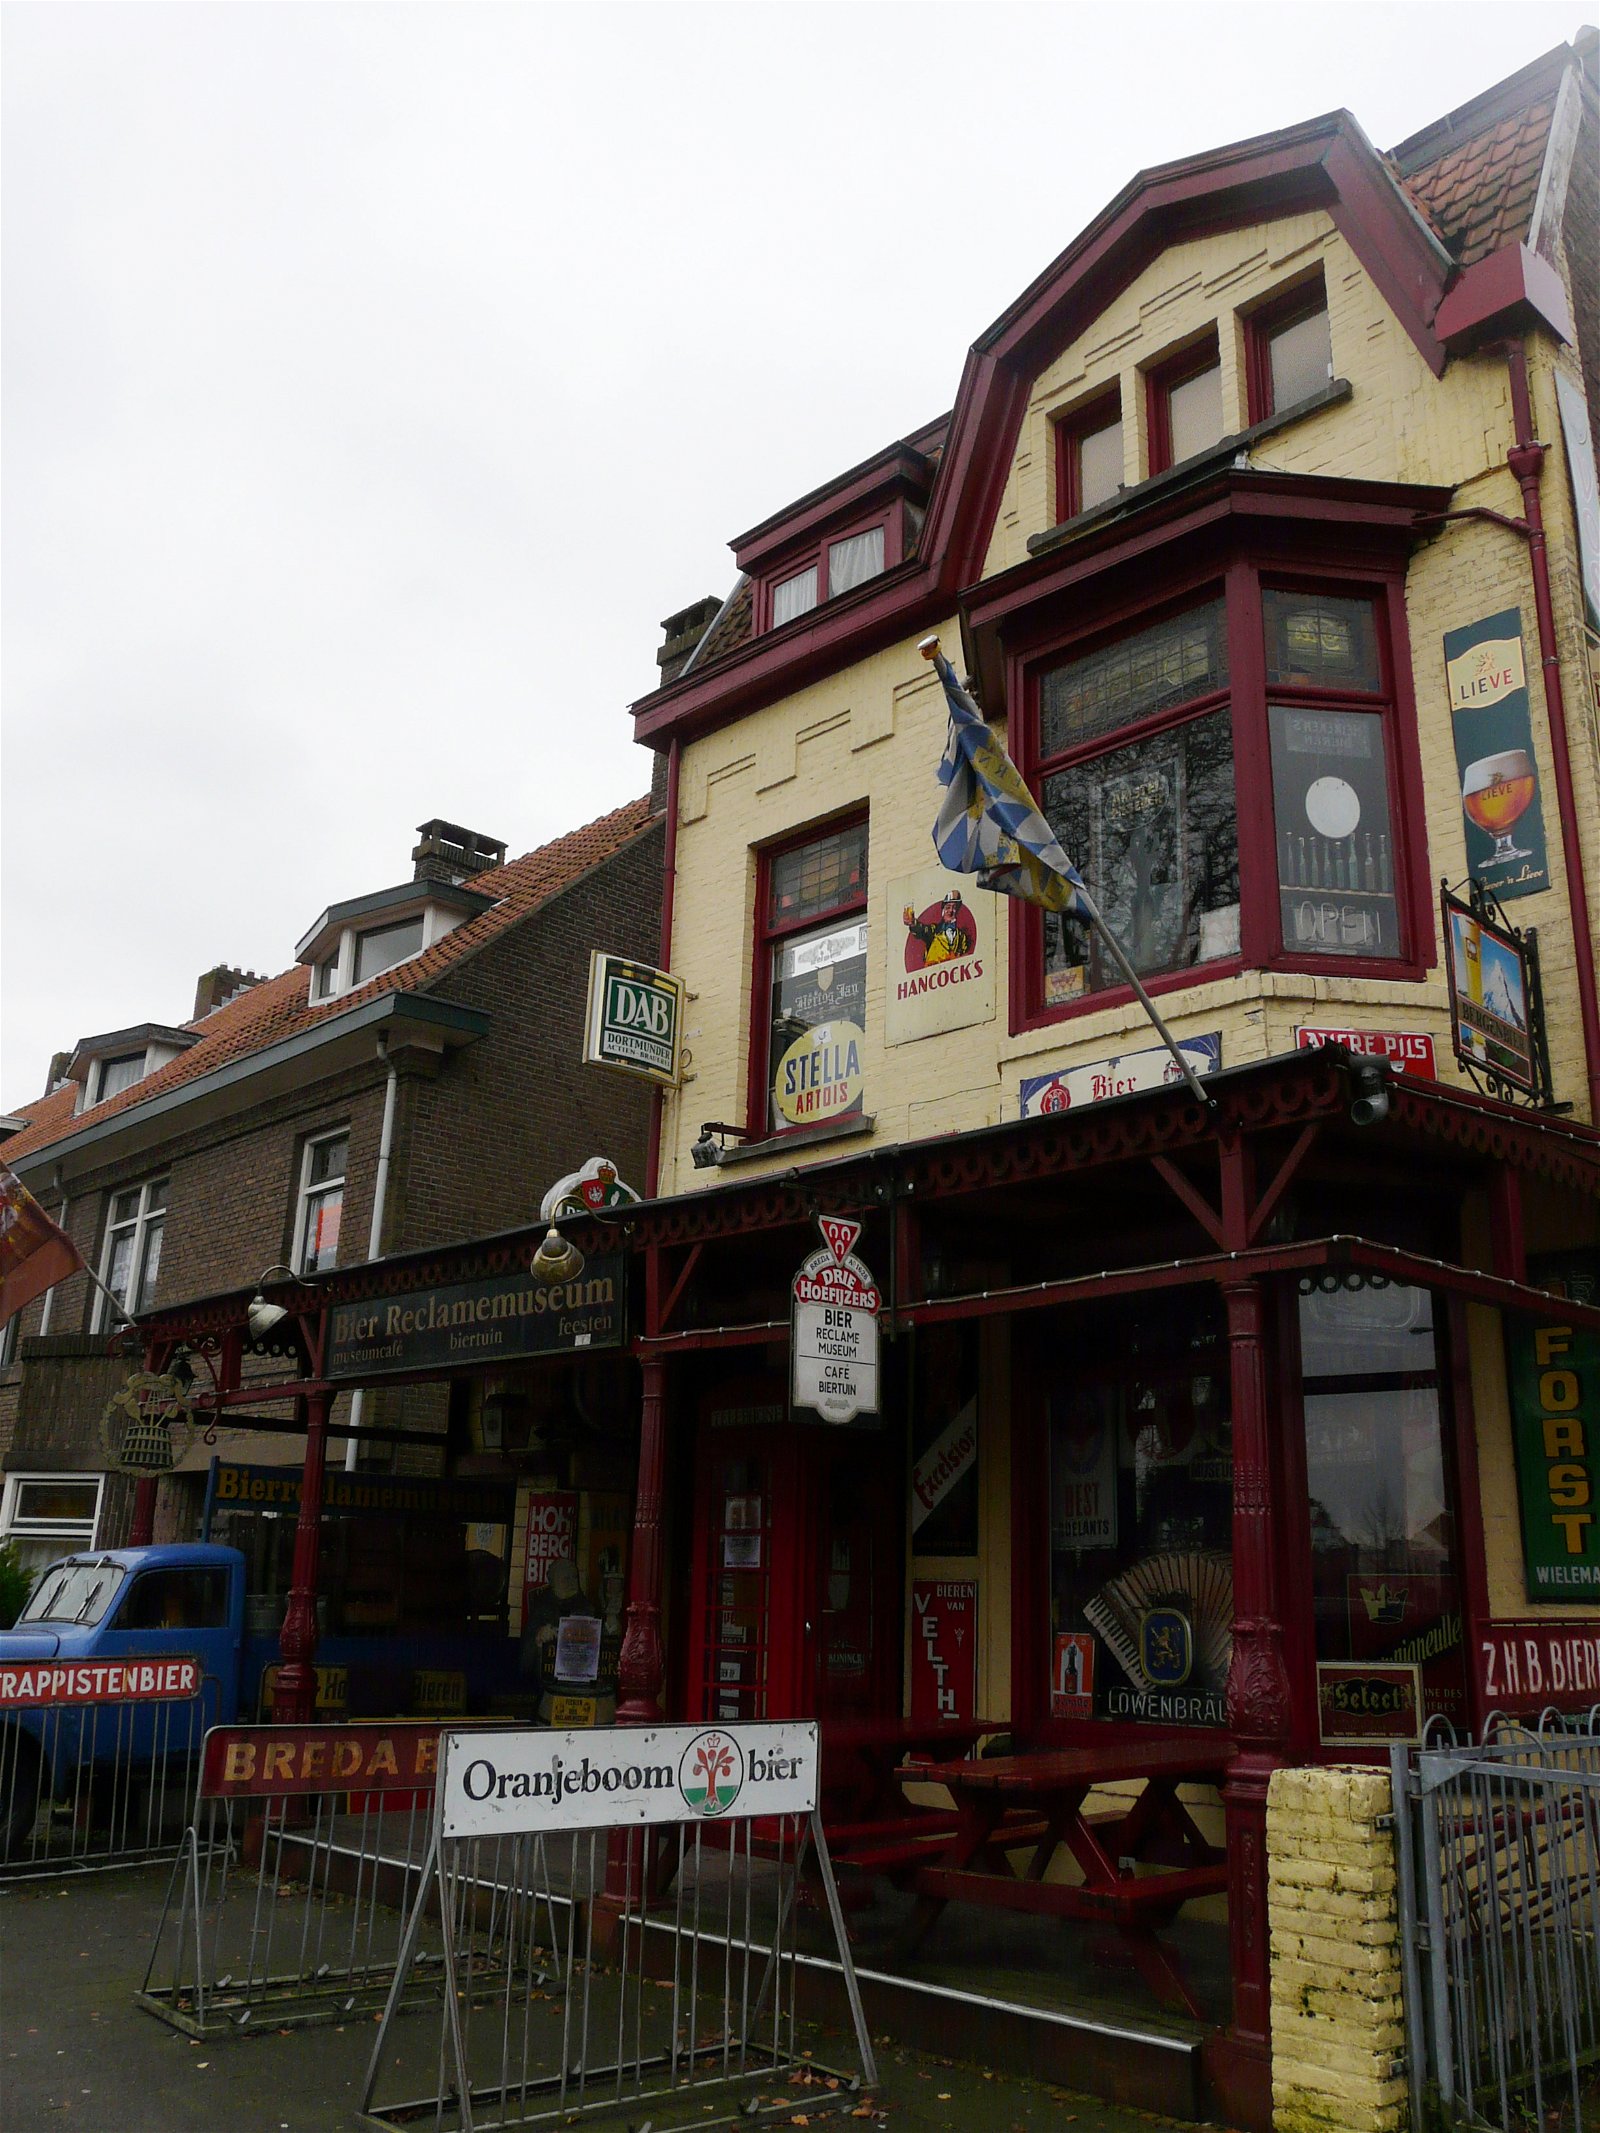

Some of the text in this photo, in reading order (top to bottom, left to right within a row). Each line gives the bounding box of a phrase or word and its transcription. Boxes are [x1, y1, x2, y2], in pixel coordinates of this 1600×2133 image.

[1461, 668, 1514, 700] LIEVE
[1482, 783, 1513, 801] LIEVE
[897, 959, 984, 1000] HANCOCK'S
[614, 984, 669, 1035] DAB
[608, 1032, 671, 1060] DORTMUNDER
[1384, 1036, 1428, 1059] PILS
[785, 1039, 860, 1096] STELLA
[795, 1081, 849, 1116] ARTOIS
[1089, 1074, 1137, 1101] Bier
[809, 1254, 830, 1271] BREDA
[821, 1268, 857, 1290] DRIE
[799, 1280, 876, 1308] HOEFIJZERS
[335, 1276, 615, 1344] Bier Reclamemuseum
[824, 1309, 852, 1329] BIER
[332, 1314, 613, 1365] museumcafé biertuin feesten
[816, 1327, 860, 1344] RECLAME
[818, 1344, 857, 1358] MUSEUM
[824, 1363, 850, 1380] CAFÉ
[818, 1381, 856, 1396] BIERTUIN
[1533, 1325, 1596, 1555] FORST
[912, 1425, 975, 1510] Excelsior
[528, 1534, 570, 1558] BERG
[936, 1584, 974, 1598] BIEREN
[947, 1601, 965, 1611] VAN
[1334, 1682, 1402, 1711] Select
[223, 1738, 399, 1782] BREDA
[462, 1748, 804, 1804] Oranjeboom bier
